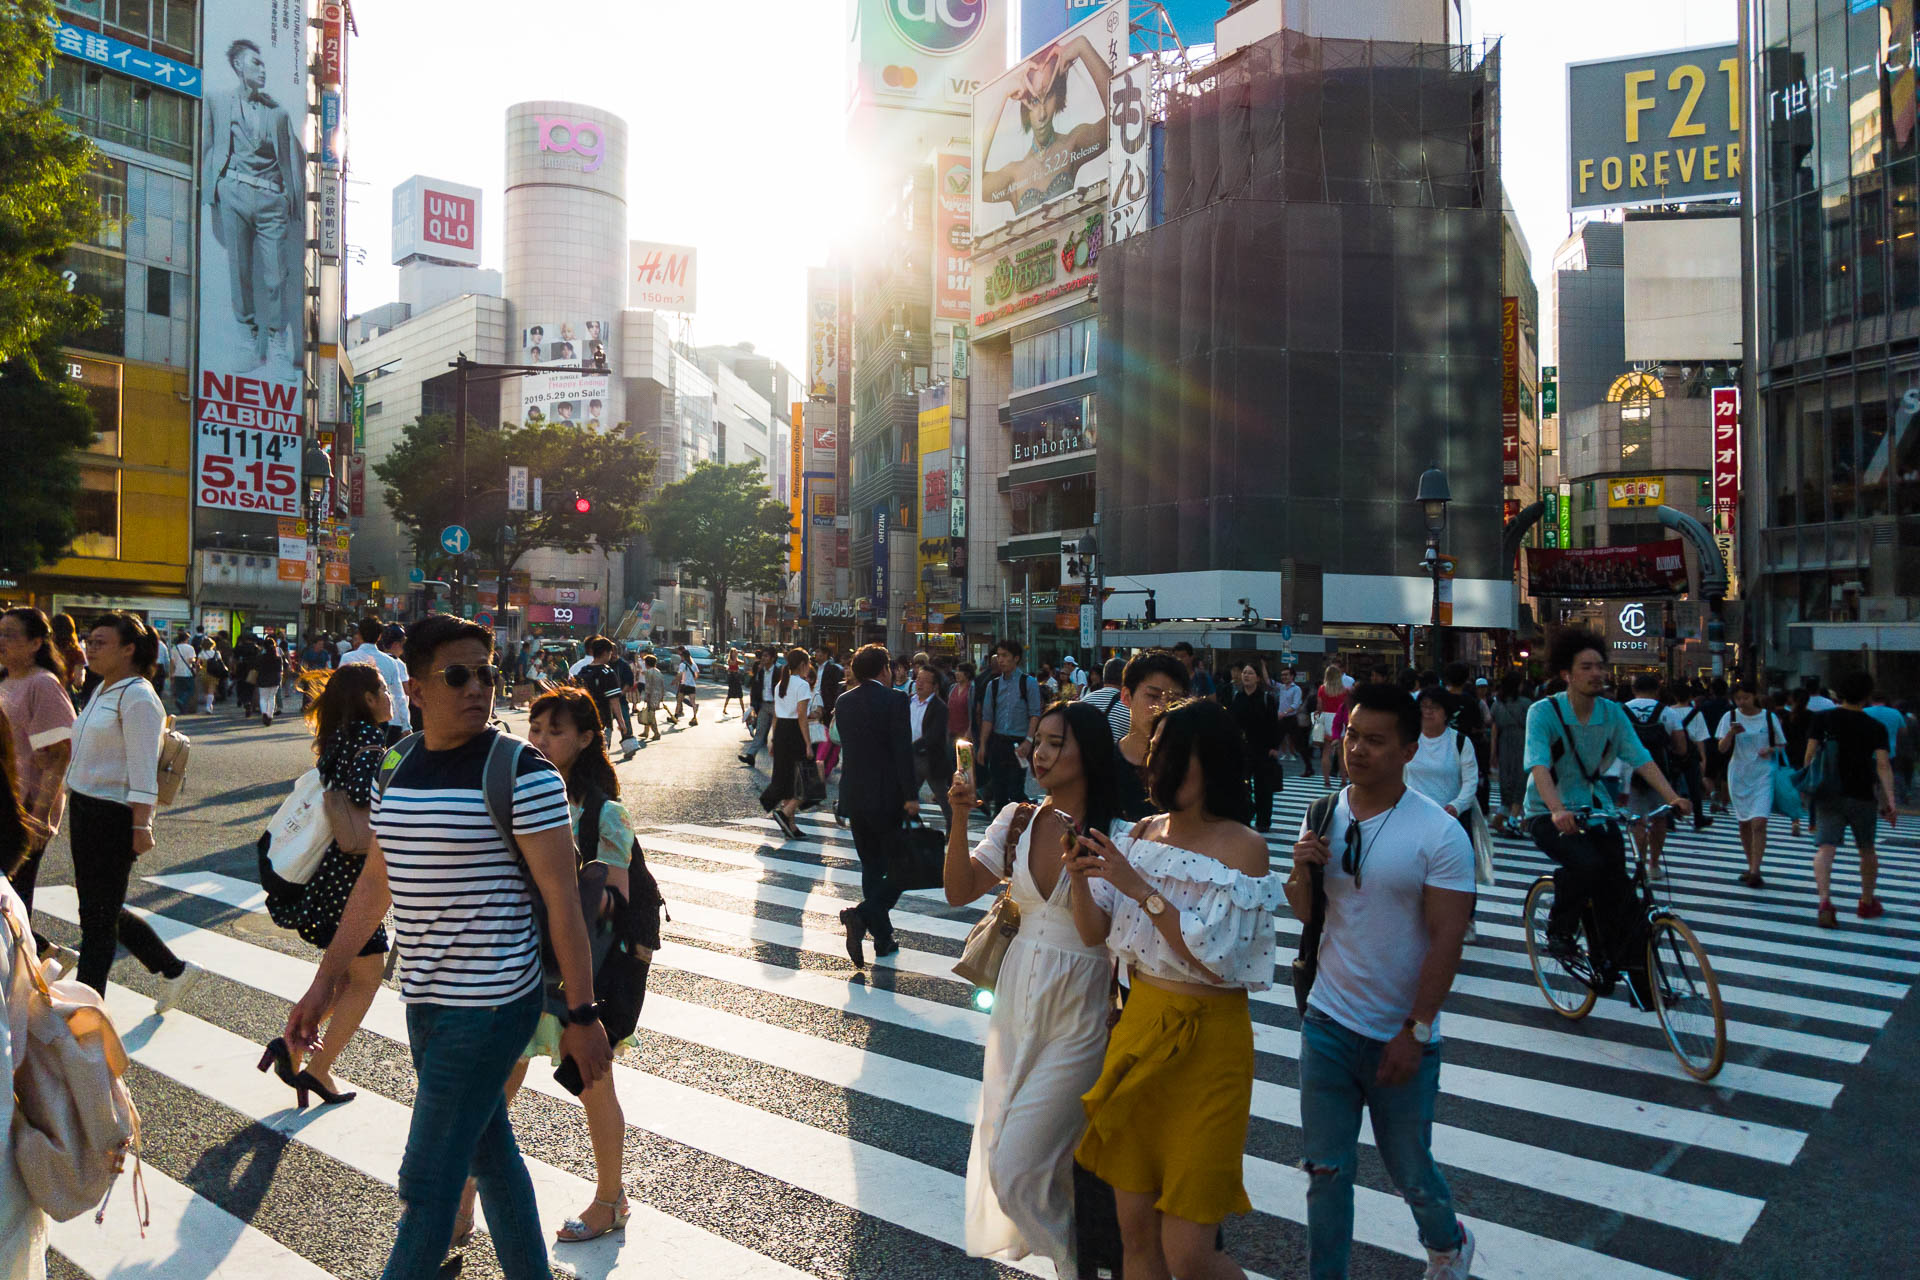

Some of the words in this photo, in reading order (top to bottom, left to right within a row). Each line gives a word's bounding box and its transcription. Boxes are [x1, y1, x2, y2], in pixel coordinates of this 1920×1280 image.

[48, 17, 196, 87] 会話イーオン
[327, 38, 338, 74] ガスト
[951, 78, 981, 95] VIS
[1624, 57, 1739, 143] F21
[535, 115, 605, 172] 109
[991, 191, 1005, 201] New
[1044, 149, 1068, 177] 5.22
[1070, 142, 1100, 163] Release
[1578, 142, 1741, 194] FOREVER
[325, 185, 335, 250] 渋谷駅前ビル
[429, 197, 465, 222] UNI
[429, 219, 469, 242] QLO
[636, 250, 689, 287] H&M
[642, 292, 673, 304] 150m
[1503, 302, 1516, 404] クスリのことなら
[203, 370, 298, 411] NEW
[354, 385, 362, 408] レイク
[525, 391, 565, 405] 2019.5.29
[201, 402, 297, 433] ALBUM
[1014, 432, 1079, 460] Euphoria
[1503, 413, 1518, 476] 三千里
[1716, 401, 1736, 487] カラオケ
[201, 454, 297, 496] 5.15
[201, 488, 236, 506] ON
[239, 492, 296, 513] SALE
[878, 513, 886, 544] MIZUHO
[553, 607, 573, 623] 109
[811, 599, 857, 617] グルメタウン
